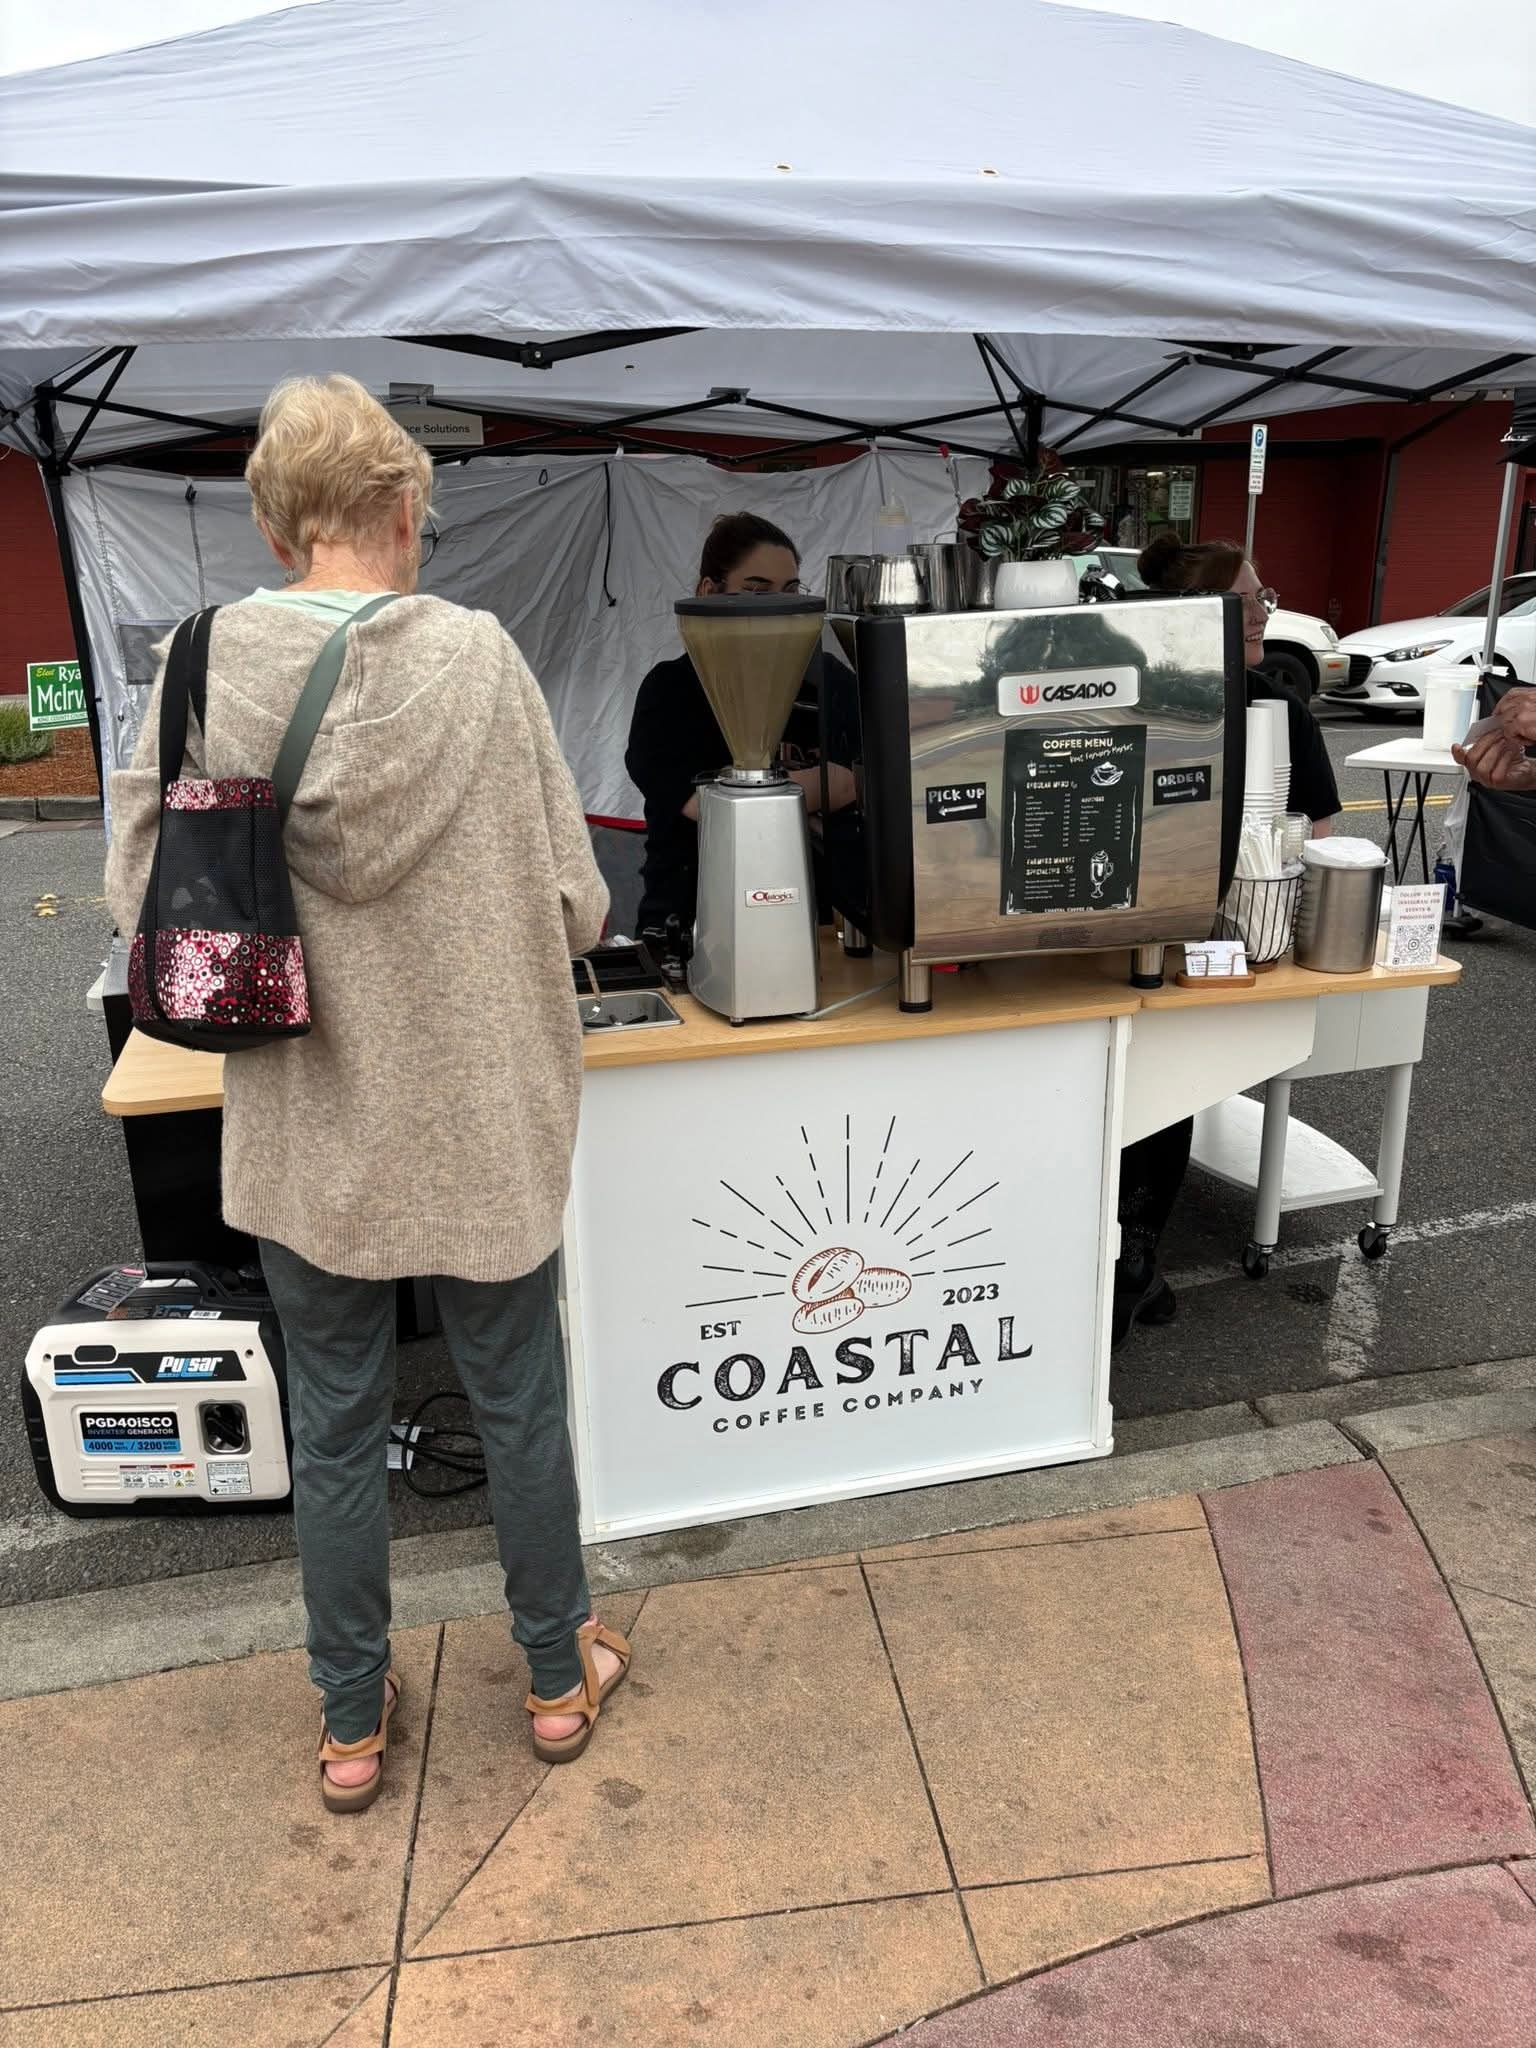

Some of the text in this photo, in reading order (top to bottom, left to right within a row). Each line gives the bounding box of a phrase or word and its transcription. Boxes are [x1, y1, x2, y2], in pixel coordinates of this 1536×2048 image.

[423, 423, 471, 434] Solutions
[58, 665, 82, 683] Rya
[36, 683, 87, 713] McIrv
[1042, 680, 1117, 702] CASADIO
[1042, 737, 1113, 750] COFFEE MENU
[1157, 771, 1205, 787] ORDER
[927, 787, 985, 804] PICK UP
[942, 1283, 999, 1306] 2023
[700, 1320, 742, 1341] EST
[157, 1356, 223, 1377] Pulsar
[656, 1315, 1033, 1411] COASTAL
[712, 1378, 984, 1433] COFFEE COMPANY
[88, 1441, 113, 1450] 4000
[137, 1440, 162, 1450] 3200
